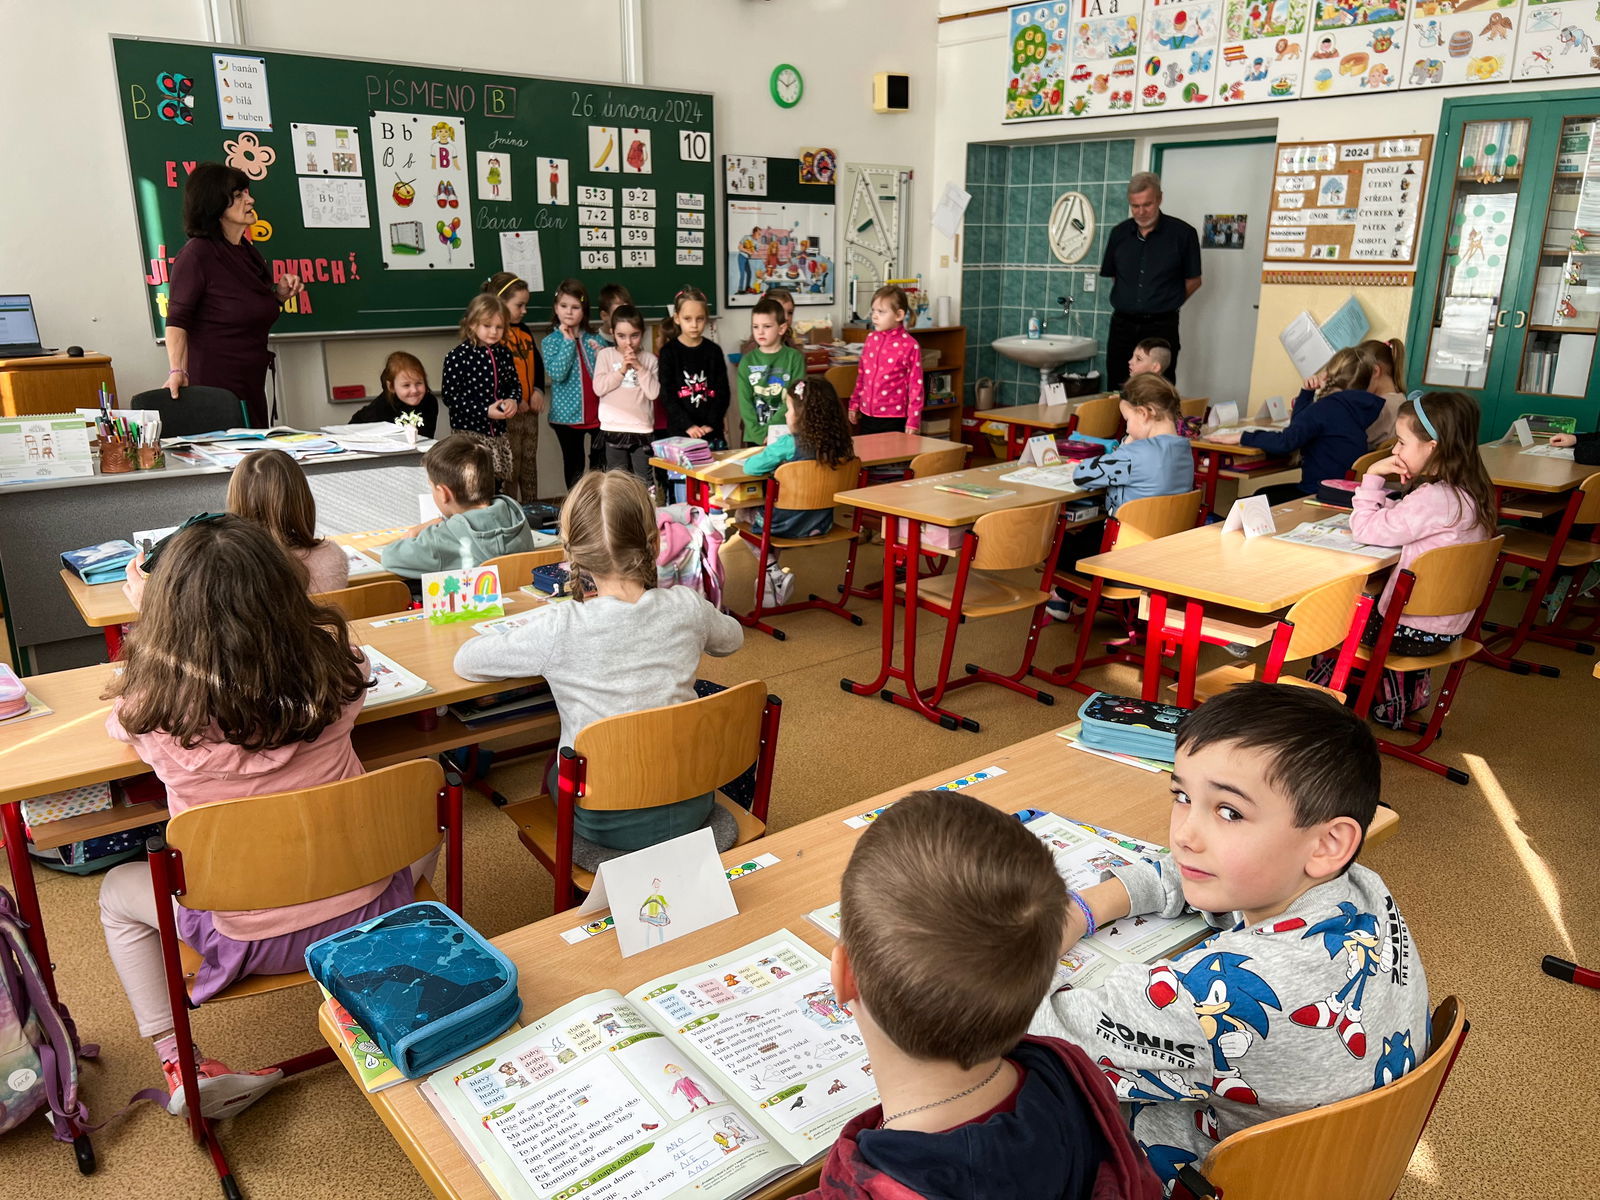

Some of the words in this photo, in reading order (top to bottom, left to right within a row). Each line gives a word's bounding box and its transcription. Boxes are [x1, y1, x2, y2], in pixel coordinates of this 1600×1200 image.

[231, 63, 258, 74] banán
[234, 80, 253, 89] bota
[366, 70, 476, 112] PÍSMENO
[492, 89, 506, 113] B
[131, 84, 151, 120] B
[602, 92, 664, 122] února
[664, 100, 704, 124] 2024
[238, 112, 264, 122] buben
[381, 122, 395, 140] B
[402, 124, 413, 141] b
[683, 133, 706, 160] 10
[1345, 148, 1369, 157] 2024
[439, 147, 451, 169] B
[1366, 166, 1400, 174] PONDĚLÍ
[1368, 180, 1394, 188] ÚTERÝ
[1364, 194, 1393, 202] STŘEDA
[476, 206, 523, 230] Bára
[534, 208, 568, 229] Ben
[1359, 208, 1394, 217] ČTVRTEK
[1362, 222, 1387, 231] PÁTEK
[1355, 248, 1385, 256] NEDĚLE
[690, 1026, 711, 1037] Venku
[698, 1033, 715, 1043] Ráno
[716, 1026, 734, 1036] máme
[726, 1033, 739, 1041] jsou
[739, 1026, 756, 1035] stopy
[1096, 1027, 1117, 1045] THE
[1099, 1011, 1196, 1059] SONIC
[582, 1040, 602, 1053] Praha
[711, 1045, 731, 1057] Klára
[730, 1037, 747, 1047] našla
[747, 1031, 764, 1041] stopy
[718, 1052, 734, 1062] Táta
[734, 1041, 761, 1056] pozoruje
[761, 1035, 777, 1044] stopy
[830, 1044, 842, 1053] had
[519, 1049, 539, 1062] kruhy
[524, 1055, 544, 1068] dráhy
[726, 1062, 735, 1070] Ty
[736, 1053, 753, 1064] našel
[773, 1058, 791, 1067] vrána
[530, 1061, 549, 1074] dlahy
[732, 1067, 746, 1076] Pes
[761, 1052, 778, 1062] kunu
[780, 1064, 797, 1075] prase
[469, 1075, 490, 1087] hlavy
[786, 1070, 803, 1080] kuna
[474, 1081, 494, 1093] hlasy
[479, 1087, 500, 1100] hrady
[484, 1093, 505, 1106] hrany
[496, 1114, 516, 1127] Hana
[517, 1109, 525, 1117] je
[527, 1100, 546, 1111] sama
[520, 1113, 536, 1125] úkol
[544, 1103, 558, 1114] pak
[506, 1132, 521, 1142] Má
[522, 1120, 544, 1133] veliký
[546, 1109, 565, 1122] papír
[524, 1154, 541, 1165] Tam
[542, 1138, 567, 1155] maluje
[569, 1128, 585, 1141] levé
[586, 1119, 603, 1131] oko,
[603, 1107, 624, 1122] pravé
[625, 1097, 641, 1109] oko,
[512, 1133, 539, 1149] Maluje
[540, 1122, 559, 1136] malý
[518, 1148, 530, 1158] To
[531, 1144, 538, 1153] je
[540, 1135, 557, 1148] jako
[529, 1164, 546, 1174] nos,
[547, 1150, 568, 1165] pusu,
[589, 1124, 613, 1140] dlouhé
[665, 1137, 684, 1153] ANO
[534, 1171, 551, 1183] Pak
[551, 1154, 578, 1172] maluje
[540, 1166, 578, 1190] Domaluje
[579, 1156, 597, 1169] také
[596, 1145, 616, 1158] ruce,
[616, 1132, 635, 1147] nohy
[597, 1165, 617, 1179] napiš
[592, 1183, 612, 1197] sama
[613, 1170, 637, 1185] doma.
[630, 1189, 643, 1200] uši
[650, 1180, 656, 1188] 2
[657, 1171, 677, 1185] nosy.
